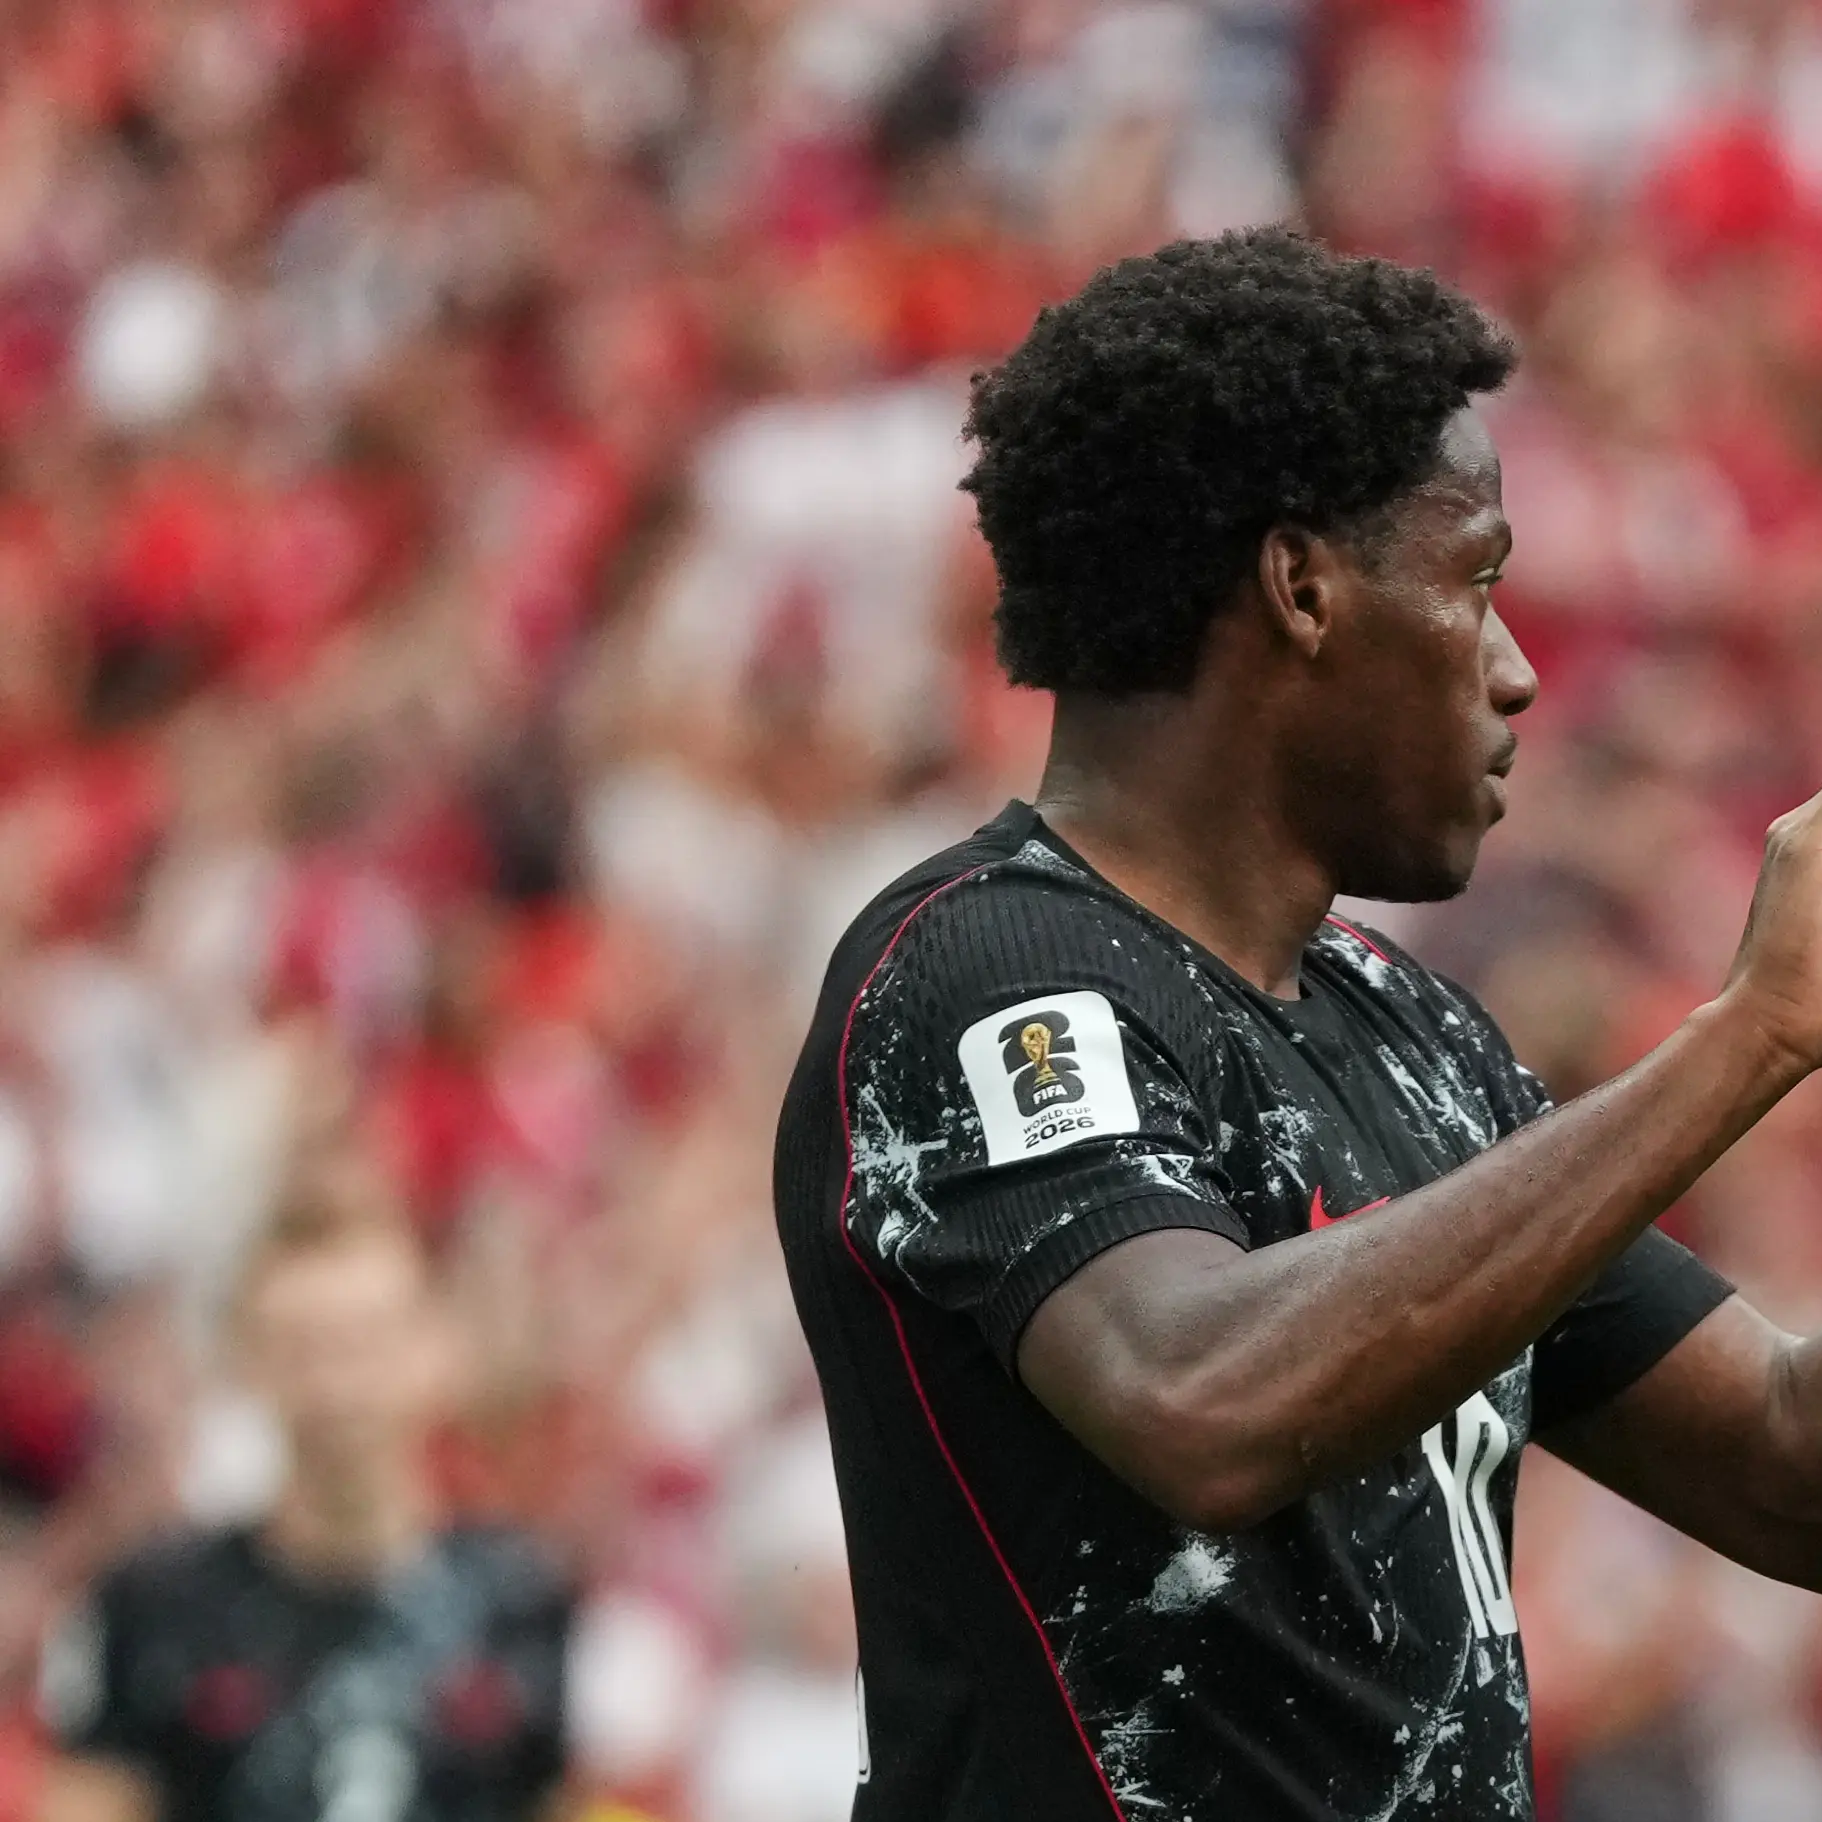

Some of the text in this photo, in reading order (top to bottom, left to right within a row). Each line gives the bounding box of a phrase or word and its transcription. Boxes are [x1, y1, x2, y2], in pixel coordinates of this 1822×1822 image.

[1032, 1083, 1068, 1105] FIFA
[1023, 1106, 1092, 1134] WORLD CUP
[1025, 1116, 1096, 1150] 2026
